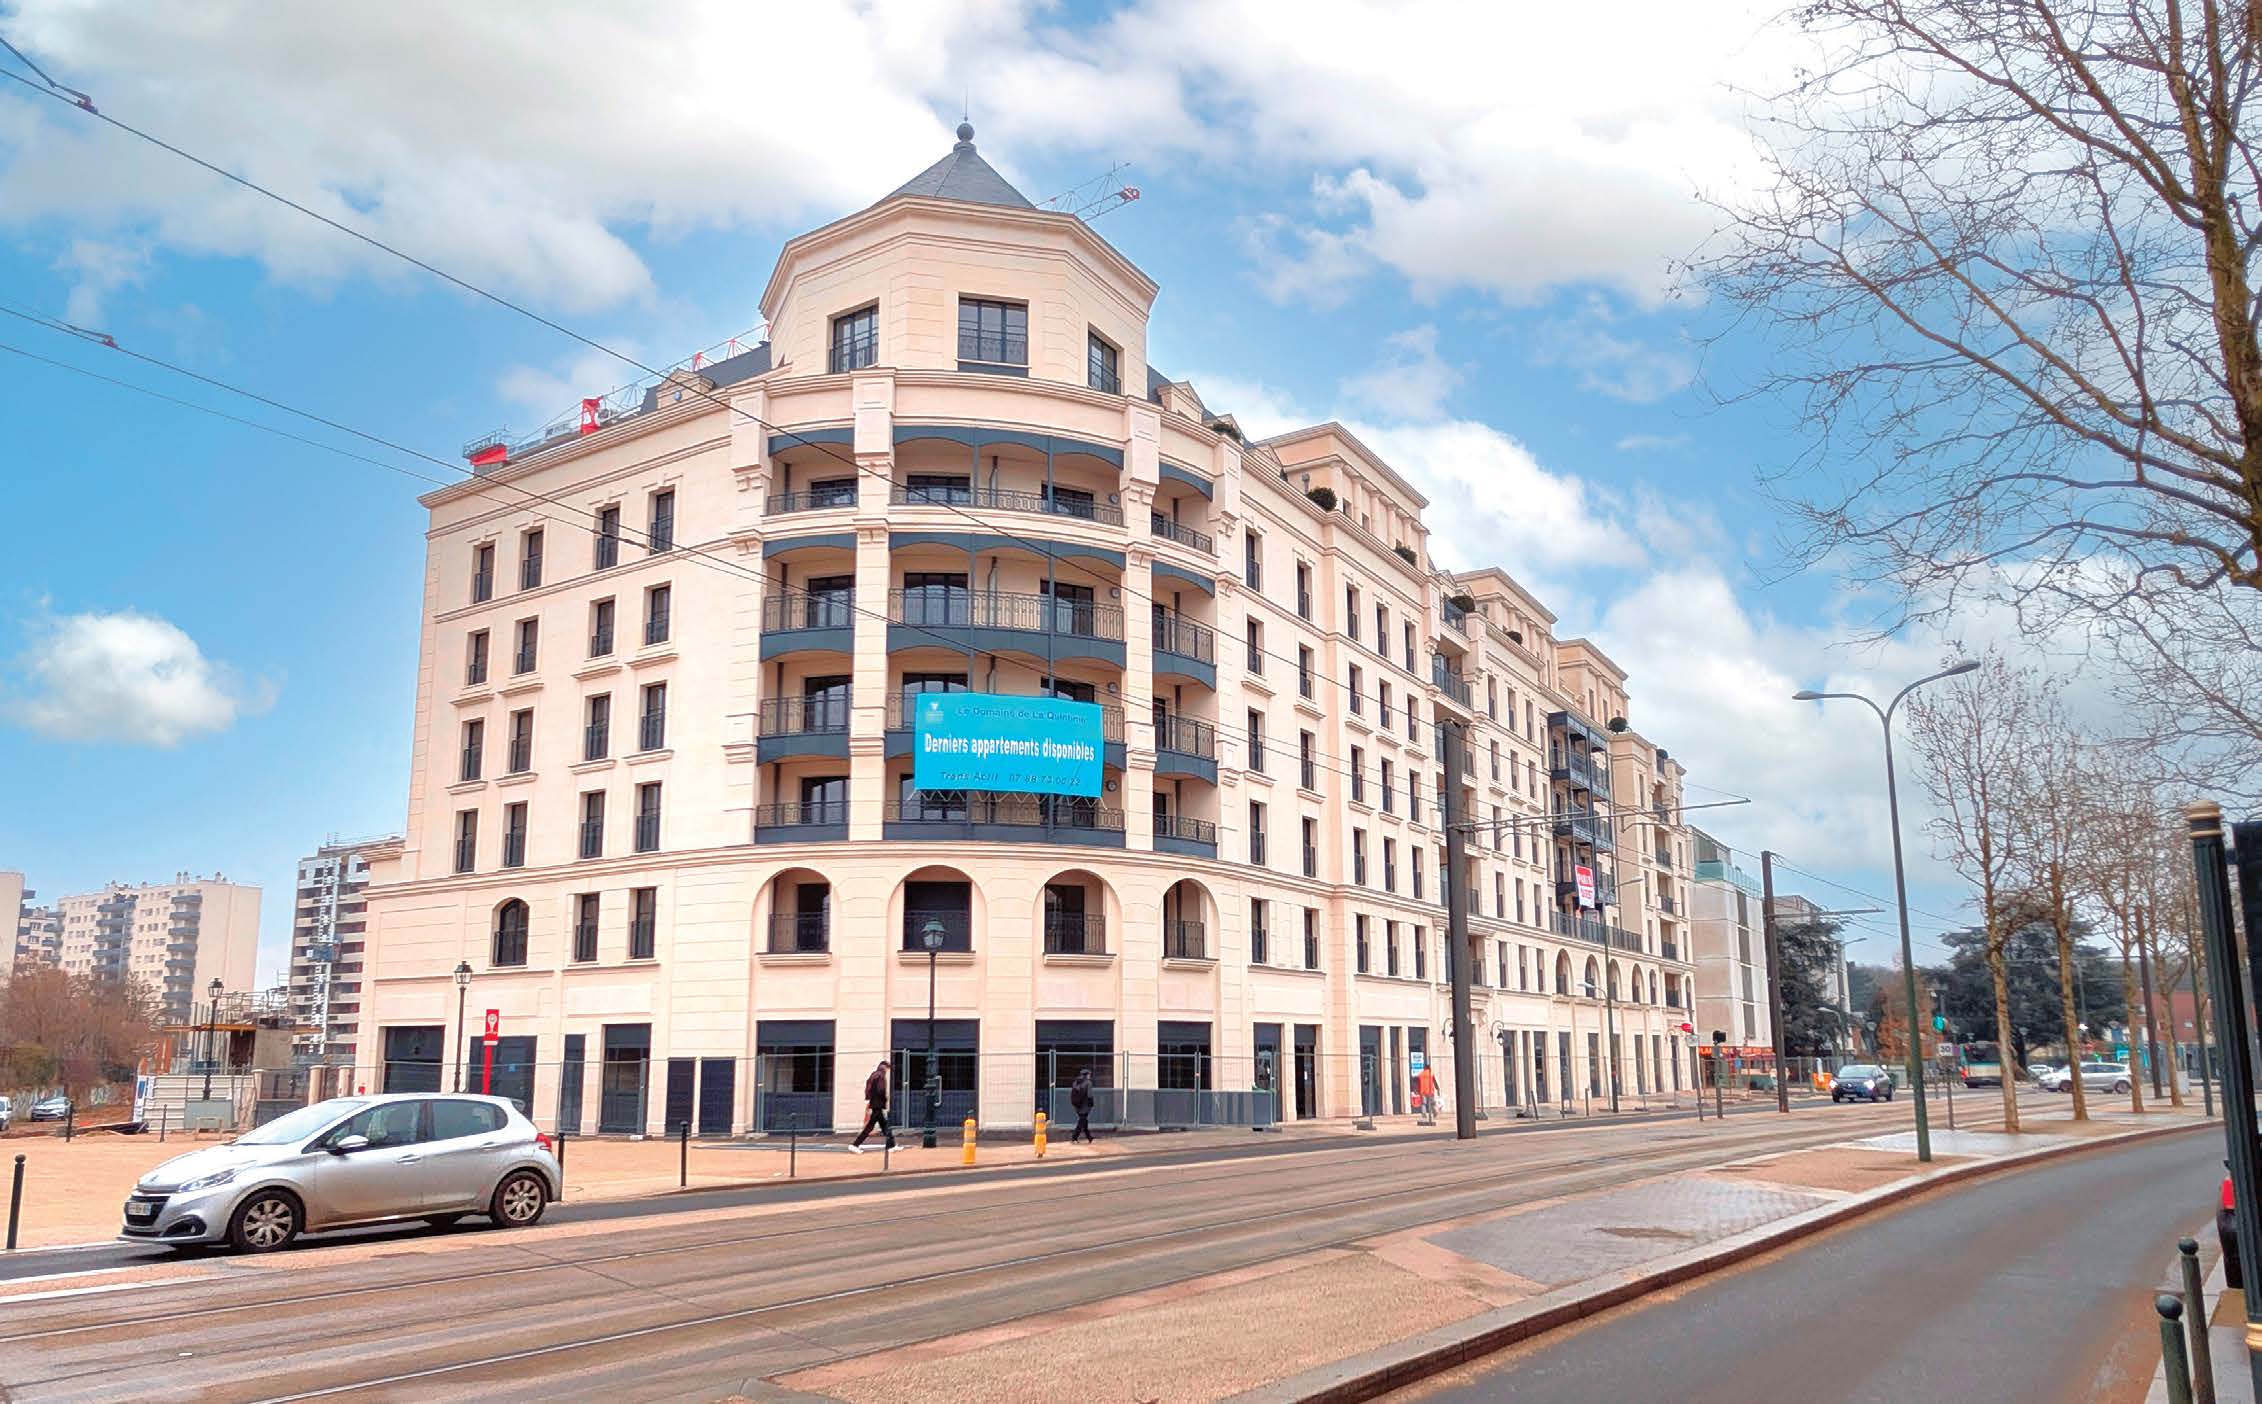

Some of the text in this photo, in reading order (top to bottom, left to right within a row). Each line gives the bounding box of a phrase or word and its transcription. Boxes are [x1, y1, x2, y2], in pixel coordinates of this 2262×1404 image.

[925, 733, 1094, 763] Derniers appartements disponibles
